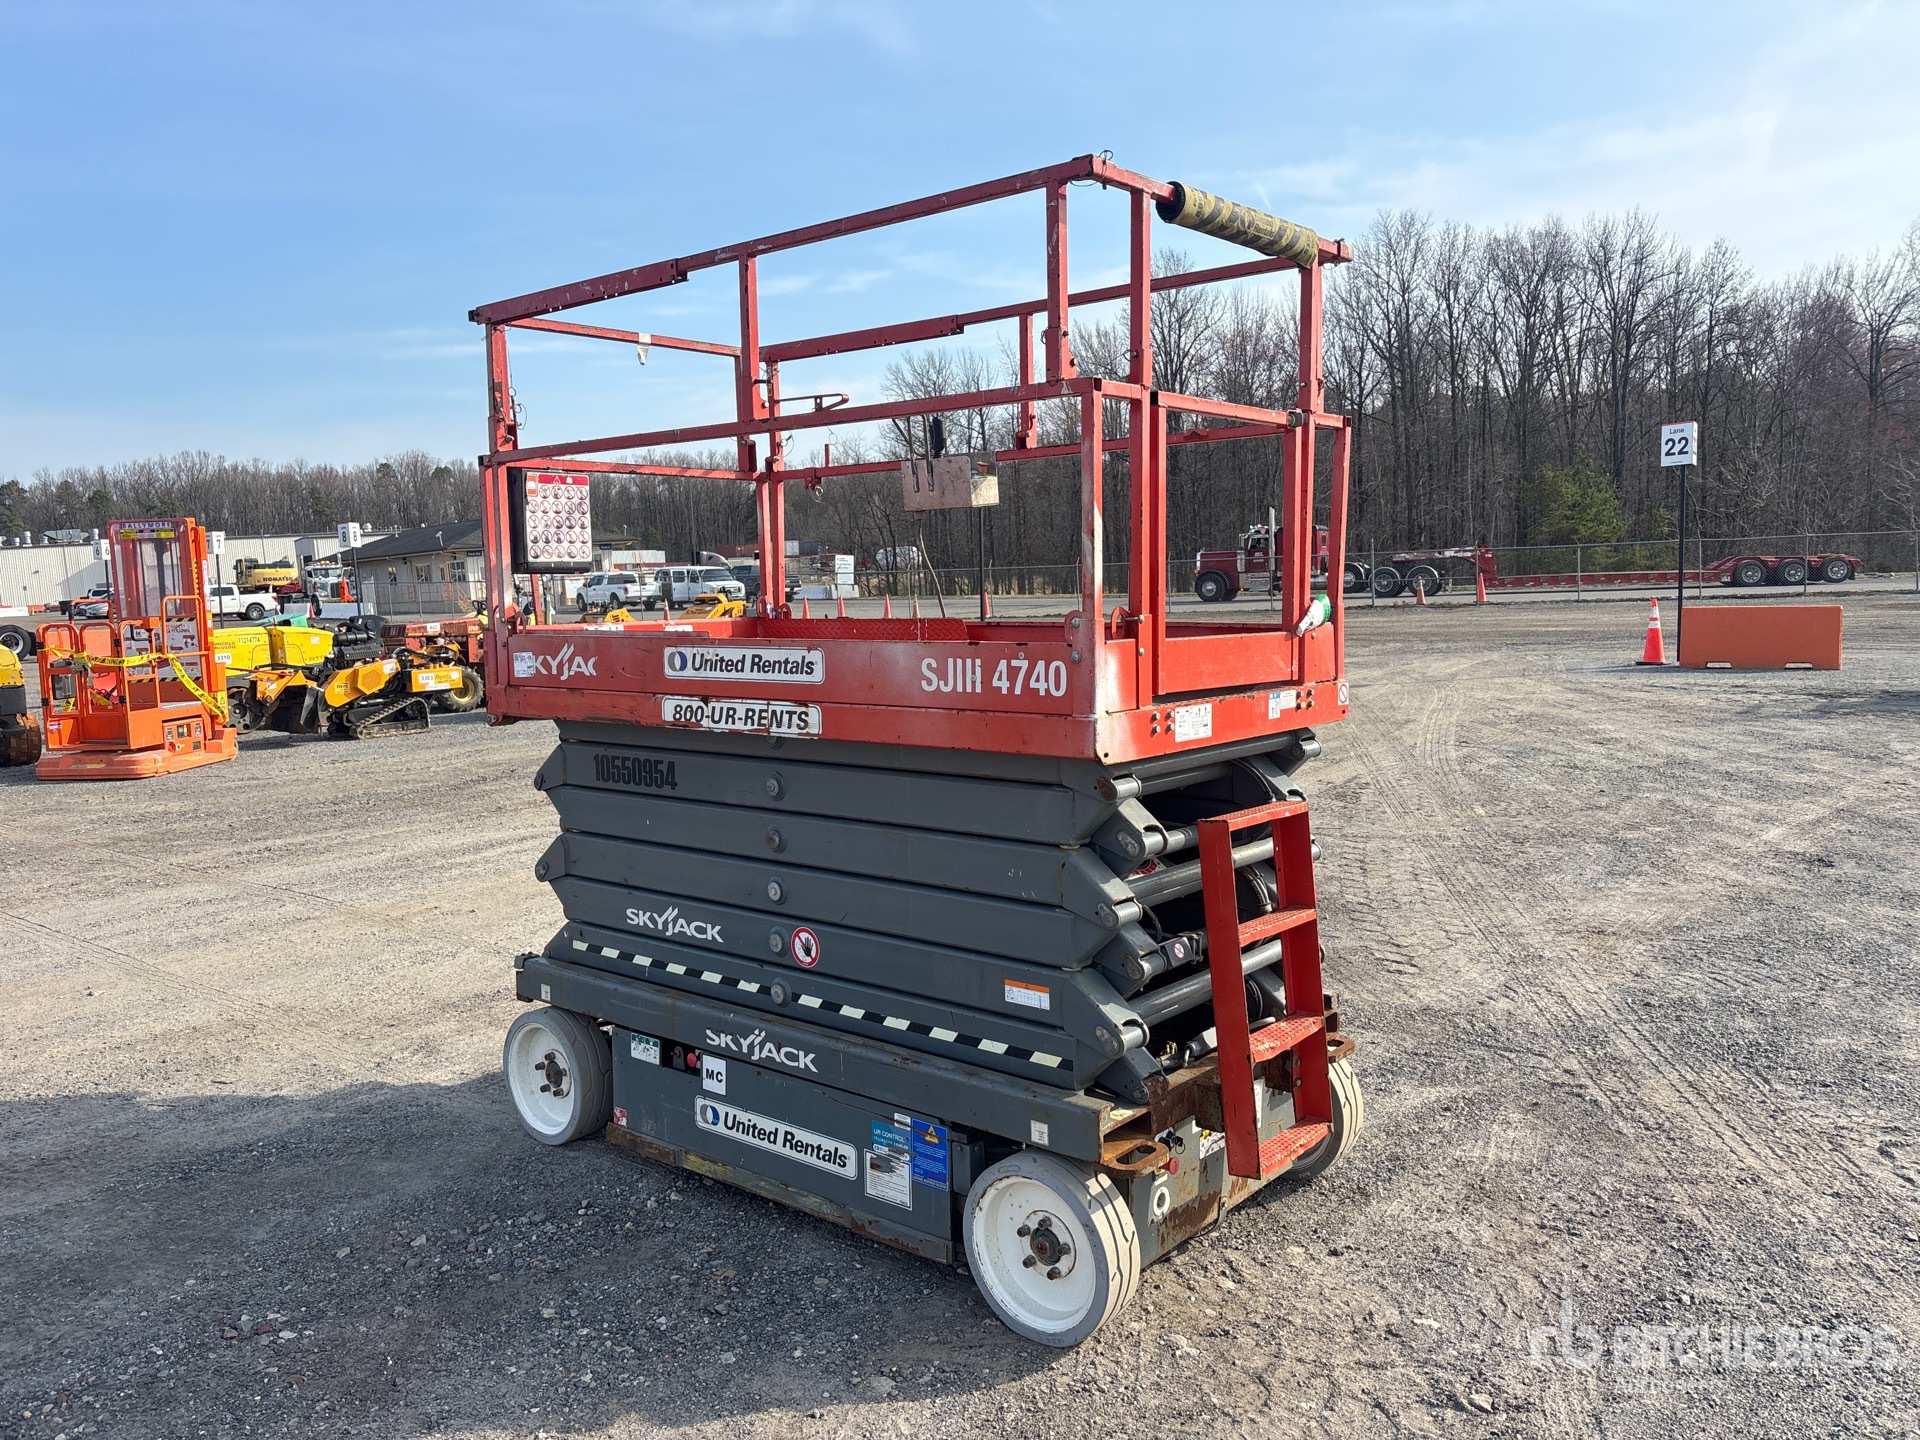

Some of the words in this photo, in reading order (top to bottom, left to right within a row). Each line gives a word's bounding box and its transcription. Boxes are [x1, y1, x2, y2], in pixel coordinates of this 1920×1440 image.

[1664, 436, 1689, 457] 22
[122, 521, 172, 529] BALLYMORE
[353, 530, 358, 541] 8
[216, 539, 221, 549] 7
[341, 531, 347, 542] 8
[95, 546, 100, 556] 6
[692, 652, 746, 674] United
[750, 654, 815, 676] Rentals
[992, 659, 1067, 697] 4740
[672, 703, 810, 731] 800-UR-RENTS
[593, 753, 678, 791] 10550954
[625, 905, 725, 943] SKYJACK
[705, 1028, 819, 1073] SKYJACK
[705, 1068, 723, 1083] MC
[723, 1111, 779, 1145] United
[782, 1130, 848, 1169] Rentals
[873, 1128, 882, 1136] UR
[881, 1130, 906, 1143] CONTROL
